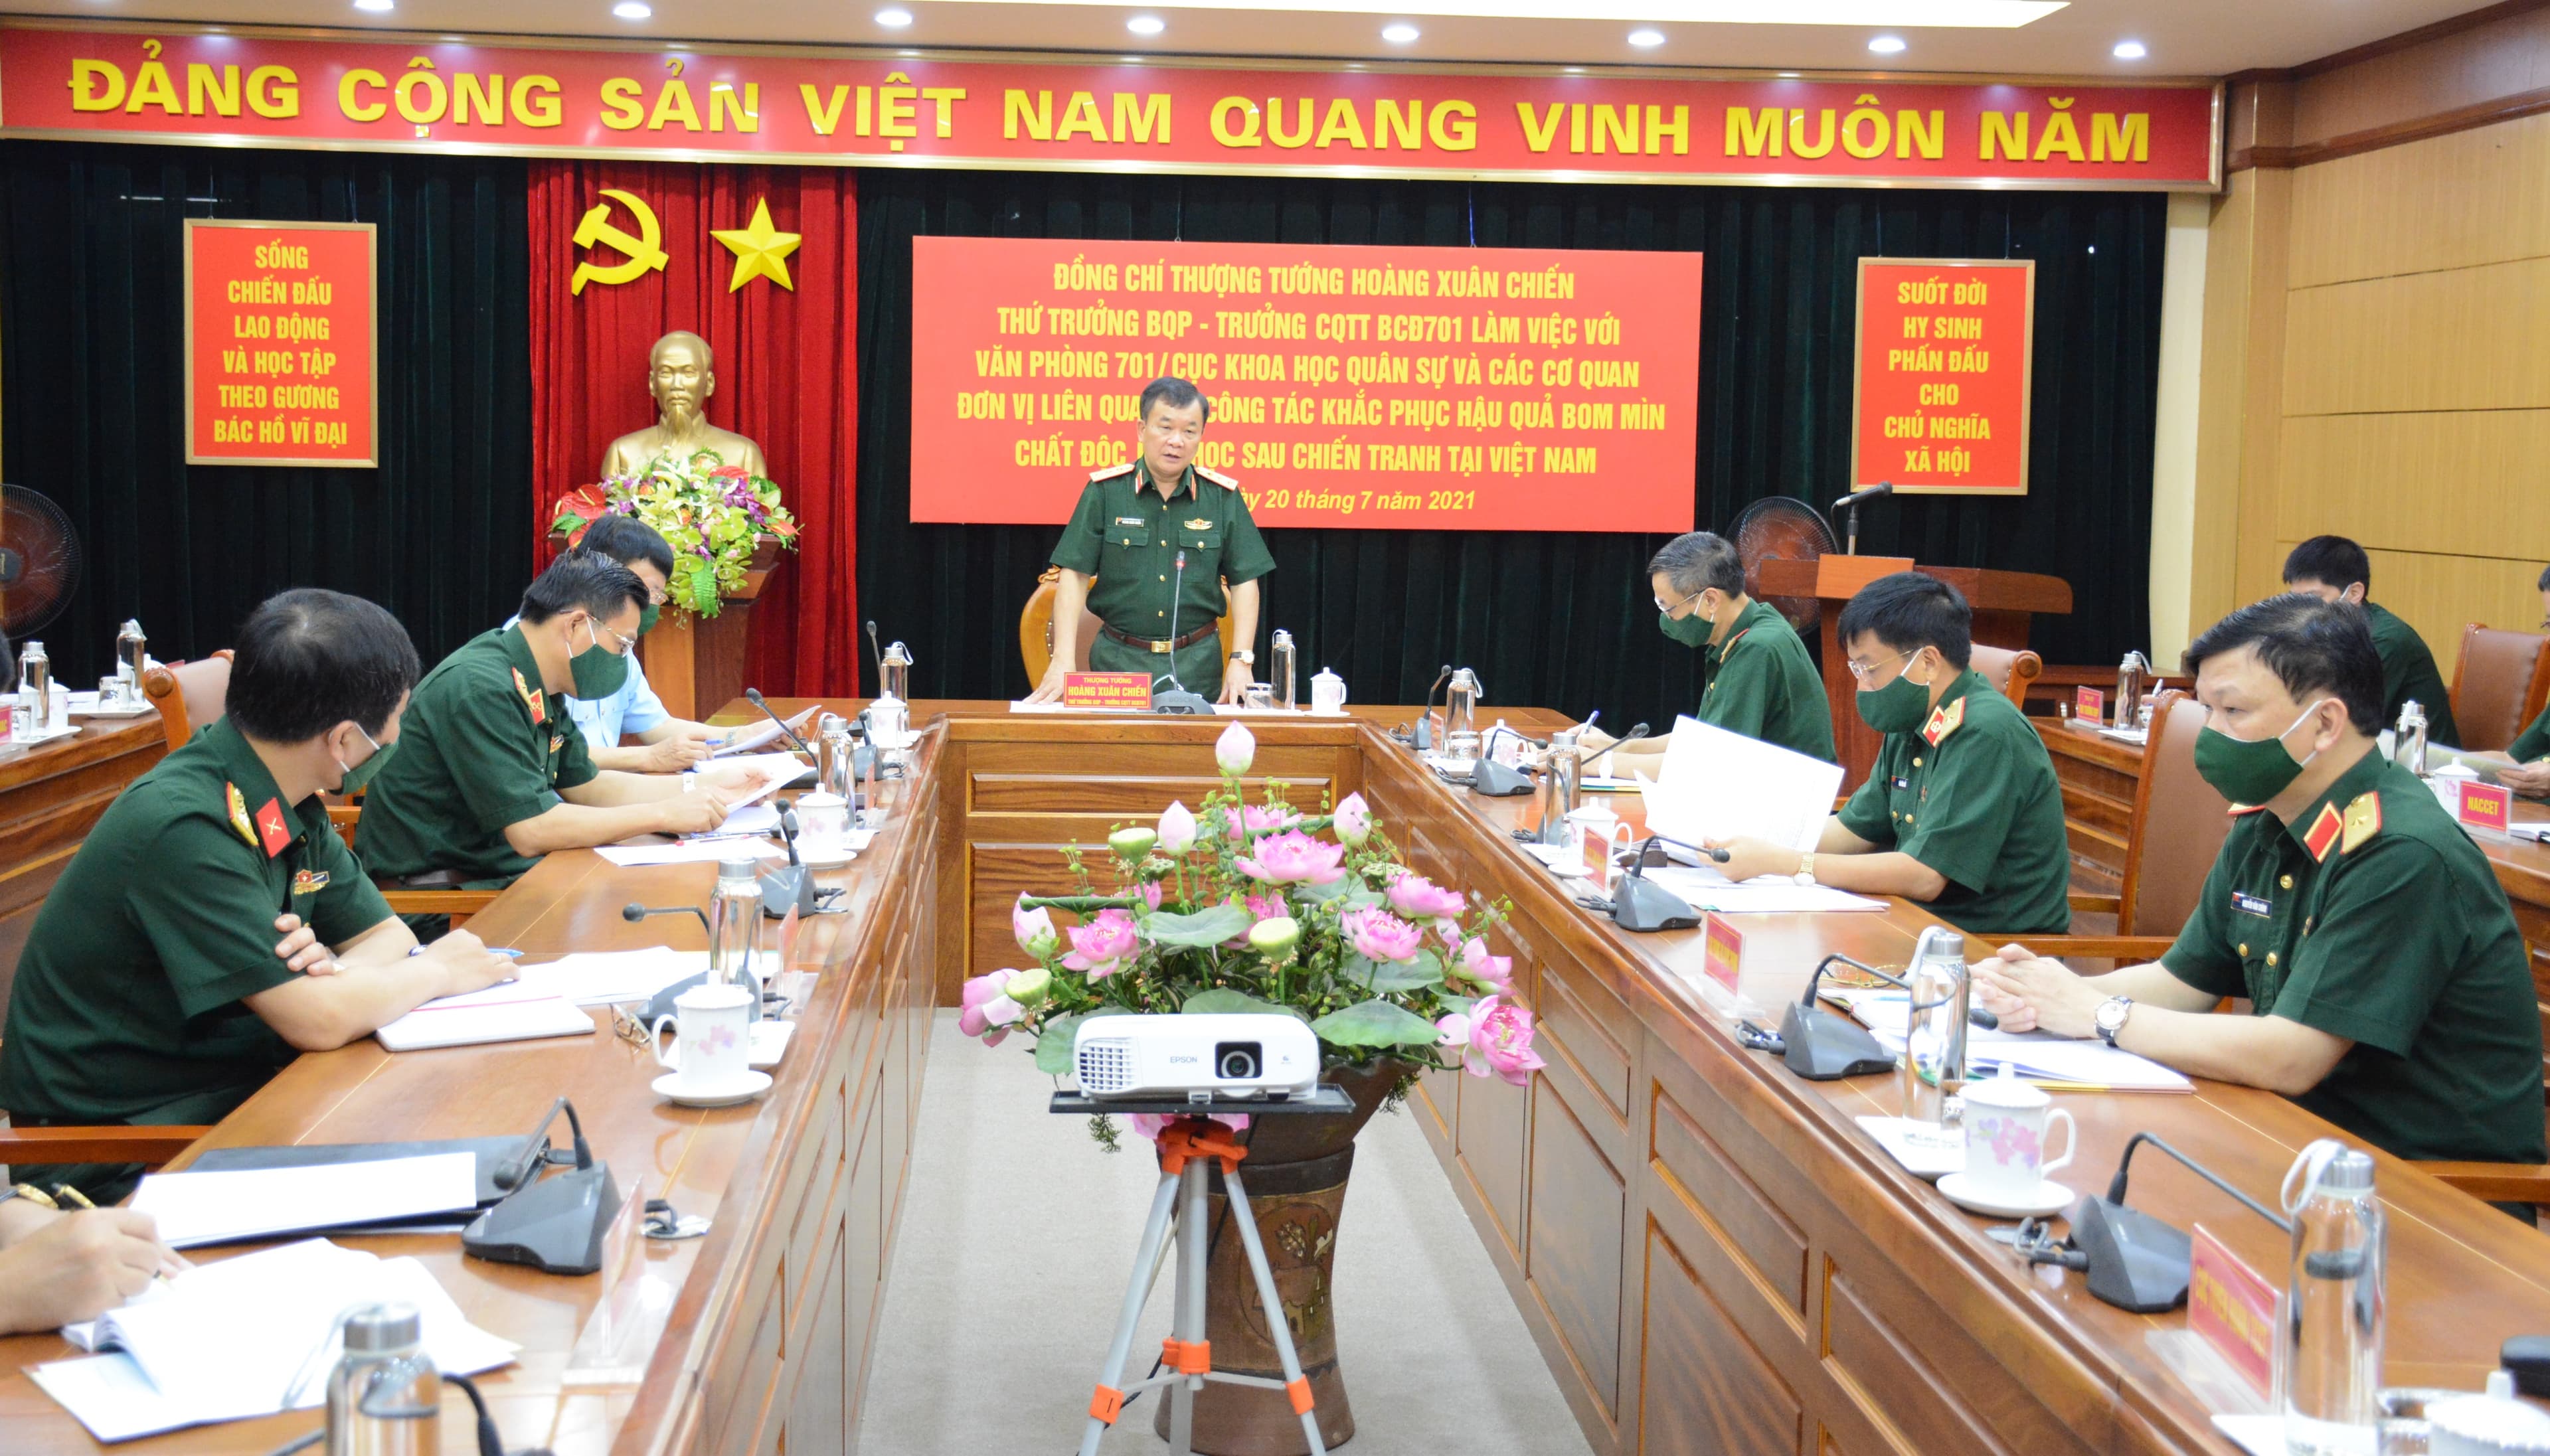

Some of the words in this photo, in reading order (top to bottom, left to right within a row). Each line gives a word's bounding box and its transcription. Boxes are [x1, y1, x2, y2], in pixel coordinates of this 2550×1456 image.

[68, 40, 299, 118] ĐẢNG
[339, 57, 561, 137] CỘNG
[600, 59, 758, 132] SẢN
[800, 72, 966, 151] VIỆT
[1004, 89, 1171, 143] NAM
[1210, 96, 1476, 150] QUANG
[1517, 103, 1689, 154] VINH
[1725, 94, 1944, 158] MUÔN
[1980, 98, 2148, 161] NĂM
[256, 238, 308, 269] SỐNG
[228, 275, 286, 304] CHIẾN
[293, 276, 331, 305] ĐẤU
[1054, 254, 1117, 291] ĐỒNG
[1126, 259, 1163, 291] CHÍ
[1171, 264, 1261, 297] THƯỢNG
[1269, 261, 1343, 294] TƯỚNG
[1352, 264, 1429, 296] HOÀNG
[1437, 266, 1499, 297] XUÂN
[1507, 264, 1574, 299] CHIẾN
[1898, 276, 1948, 304] SUỐT
[1954, 278, 1987, 305] ĐỜI
[235, 315, 270, 338] LAO
[276, 312, 329, 343] ĐỘNG
[997, 301, 1043, 335] THỨ
[1048, 299, 1139, 336] TRƯỞNG
[1147, 310, 1192, 340] BQP
[1216, 302, 1306, 339] TRƯỞNG
[1316, 313, 1371, 343] CQTT
[1378, 315, 1462, 342] BCĐ701
[1472, 311, 1520, 343] LÀM
[1527, 312, 1577, 349] VIỆC
[1584, 311, 1620, 345] VỚI
[1904, 317, 1928, 338] HY
[1934, 317, 1982, 339] SINH
[223, 345, 248, 373] VÀ
[255, 351, 294, 378] HỌC
[300, 348, 336, 378] TẬP
[976, 345, 1022, 376] VĂN
[1030, 345, 1108, 378] PHÒNG
[1225, 354, 1286, 380] KHOA
[1294, 356, 1339, 386] HỌC
[1347, 351, 1408, 385] QUÂN
[1416, 355, 1448, 389] SỰ
[1453, 353, 1482, 384] VÀ
[1489, 353, 1533, 385] CÁC
[1542, 358, 1572, 386] CƠ
[1579, 361, 1640, 390] QUAN
[1889, 344, 1943, 372] PHẤN
[1948, 345, 1988, 372] ĐẤU
[219, 385, 267, 408] THEO
[274, 384, 339, 409] GƯƠNG
[1920, 384, 1959, 405] CHO
[958, 390, 1005, 419] ĐƠN
[1013, 393, 1034, 425] VỊ
[1041, 389, 1092, 420] LIÊN
[1100, 395, 1141, 424] QUA
[1207, 391, 1265, 423] CÔNG
[1271, 392, 1314, 424] TÁC
[1322, 389, 1383, 425] KHẮC
[1390, 400, 1450, 432] PHỤC
[1457, 396, 1502, 432] HẬU
[1509, 393, 1555, 431] QUẢ
[1562, 403, 1613, 430] BOM
[1620, 397, 1665, 430] MÌN
[1885, 410, 1924, 438] CHỦ
[1930, 414, 1990, 439] NGHĨA
[214, 416, 252, 442] BÁC
[260, 414, 285, 443] HỒ
[291, 417, 309, 444] VĨ
[315, 422, 347, 448] ĐẠI
[1016, 432, 1074, 466] CHẤT
[1080, 436, 1126, 469] ĐỘC
[1242, 442, 1286, 469] SAU
[1293, 436, 1361, 470] CHIẾN
[1368, 445, 1441, 471] TRANH
[1448, 446, 1482, 477] TẠI
[1489, 442, 1537, 477] VIỆT
[1545, 447, 1596, 473] NAM
[1905, 446, 1931, 471] XÃ
[1938, 446, 1970, 476] HỘI
[1265, 489, 1290, 508] 20
[1296, 489, 1355, 514] tháng
[1361, 491, 1373, 509] 7
[1377, 491, 1421, 509] năm
[1428, 491, 1474, 509] 2021
[1068, 685, 1096, 696] HOÀNG
[1098, 685, 1120, 696] XUÂN
[1122, 684, 1146, 697] CHIẾN
[2468, 796, 2500, 816] NACCET
